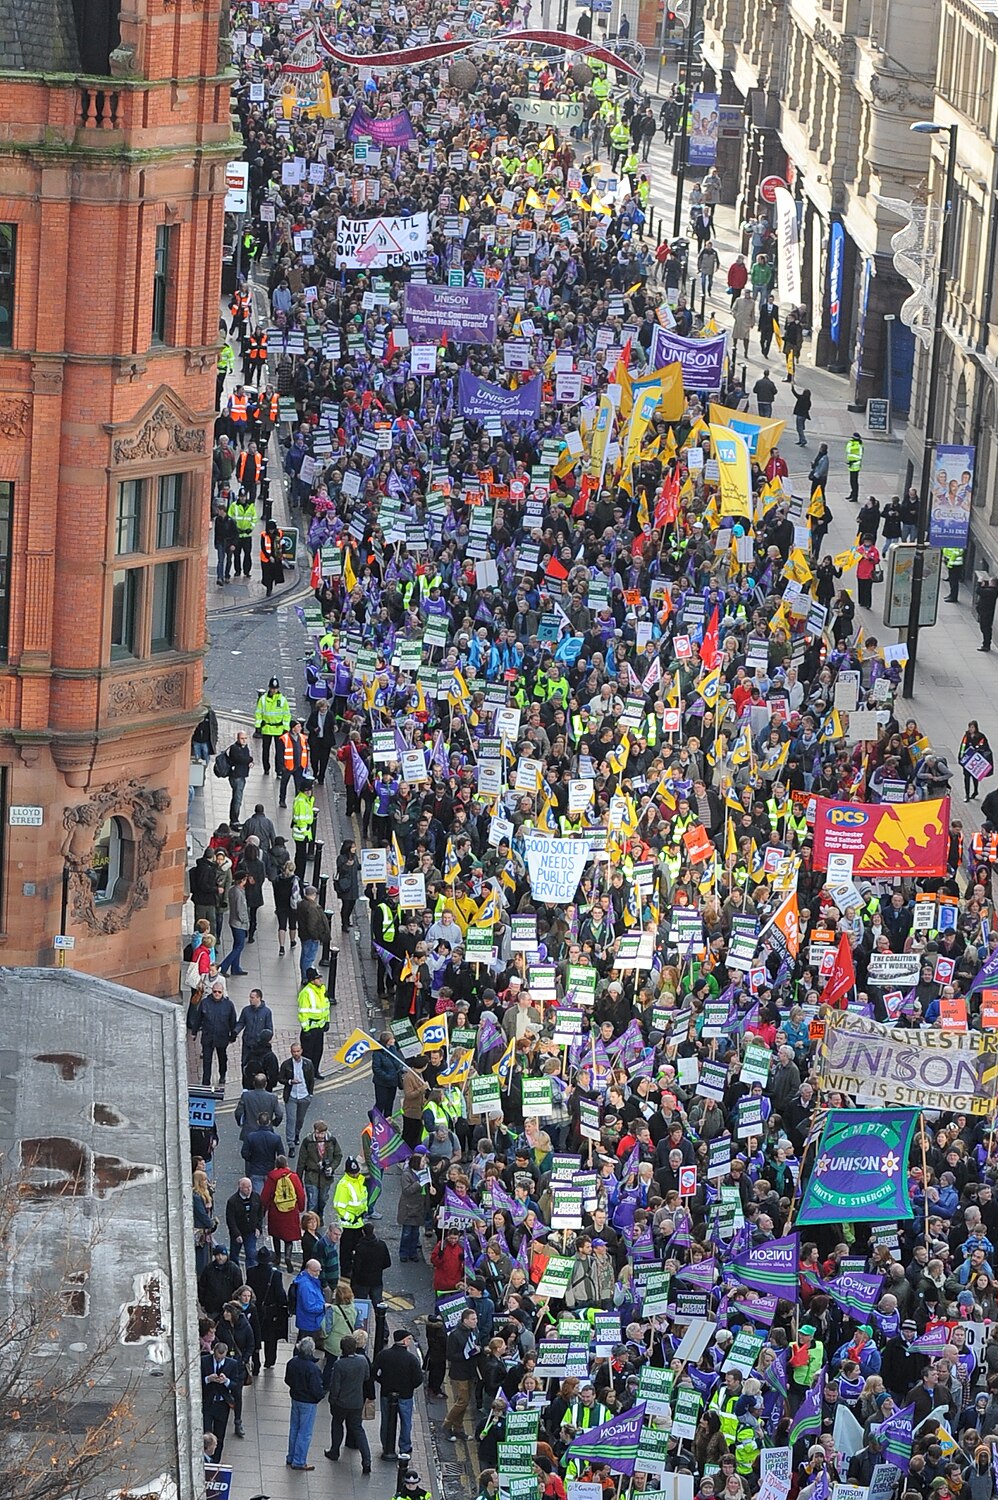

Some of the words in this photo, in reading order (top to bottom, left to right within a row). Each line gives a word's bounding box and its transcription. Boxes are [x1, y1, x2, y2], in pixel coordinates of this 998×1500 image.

[551, 103, 580, 118] CUTS
[341, 221, 369, 233] NUT
[391, 218, 418, 231] ATL
[338, 233, 366, 244] SAVE
[337, 245, 356, 256] OUR
[434, 295, 469, 304] UNISON
[406, 307, 447, 317] Manchester
[448, 312, 489, 321] Community
[412, 316, 437, 324] Mental
[438, 318, 461, 327] Health
[461, 320, 488, 329] Branch
[662, 348, 718, 365] UNISON
[477, 390, 520, 403] UNISON
[831, 809, 865, 824] pcs
[825, 829, 864, 837] Manchester
[525, 840, 549, 853] GOOD
[551, 841, 590, 854] SOCIETY
[541, 855, 574, 870] NEEDS
[537, 868, 573, 884] PUBLIC
[532, 881, 578, 897] SERVICES
[830, 1012, 998, 1052] MANCHESTER
[829, 1040, 985, 1095] UNISON
[872, 1083, 886, 1098] IS
[895, 1087, 991, 1114] STRENGTH
[830, 1156, 879, 1171] UNISON
[813, 1184, 833, 1202] UNITY
[838, 1195, 847, 1205] IS
[851, 1185, 892, 1205] STRENGTH
[508, 1412, 538, 1423] UNISON
